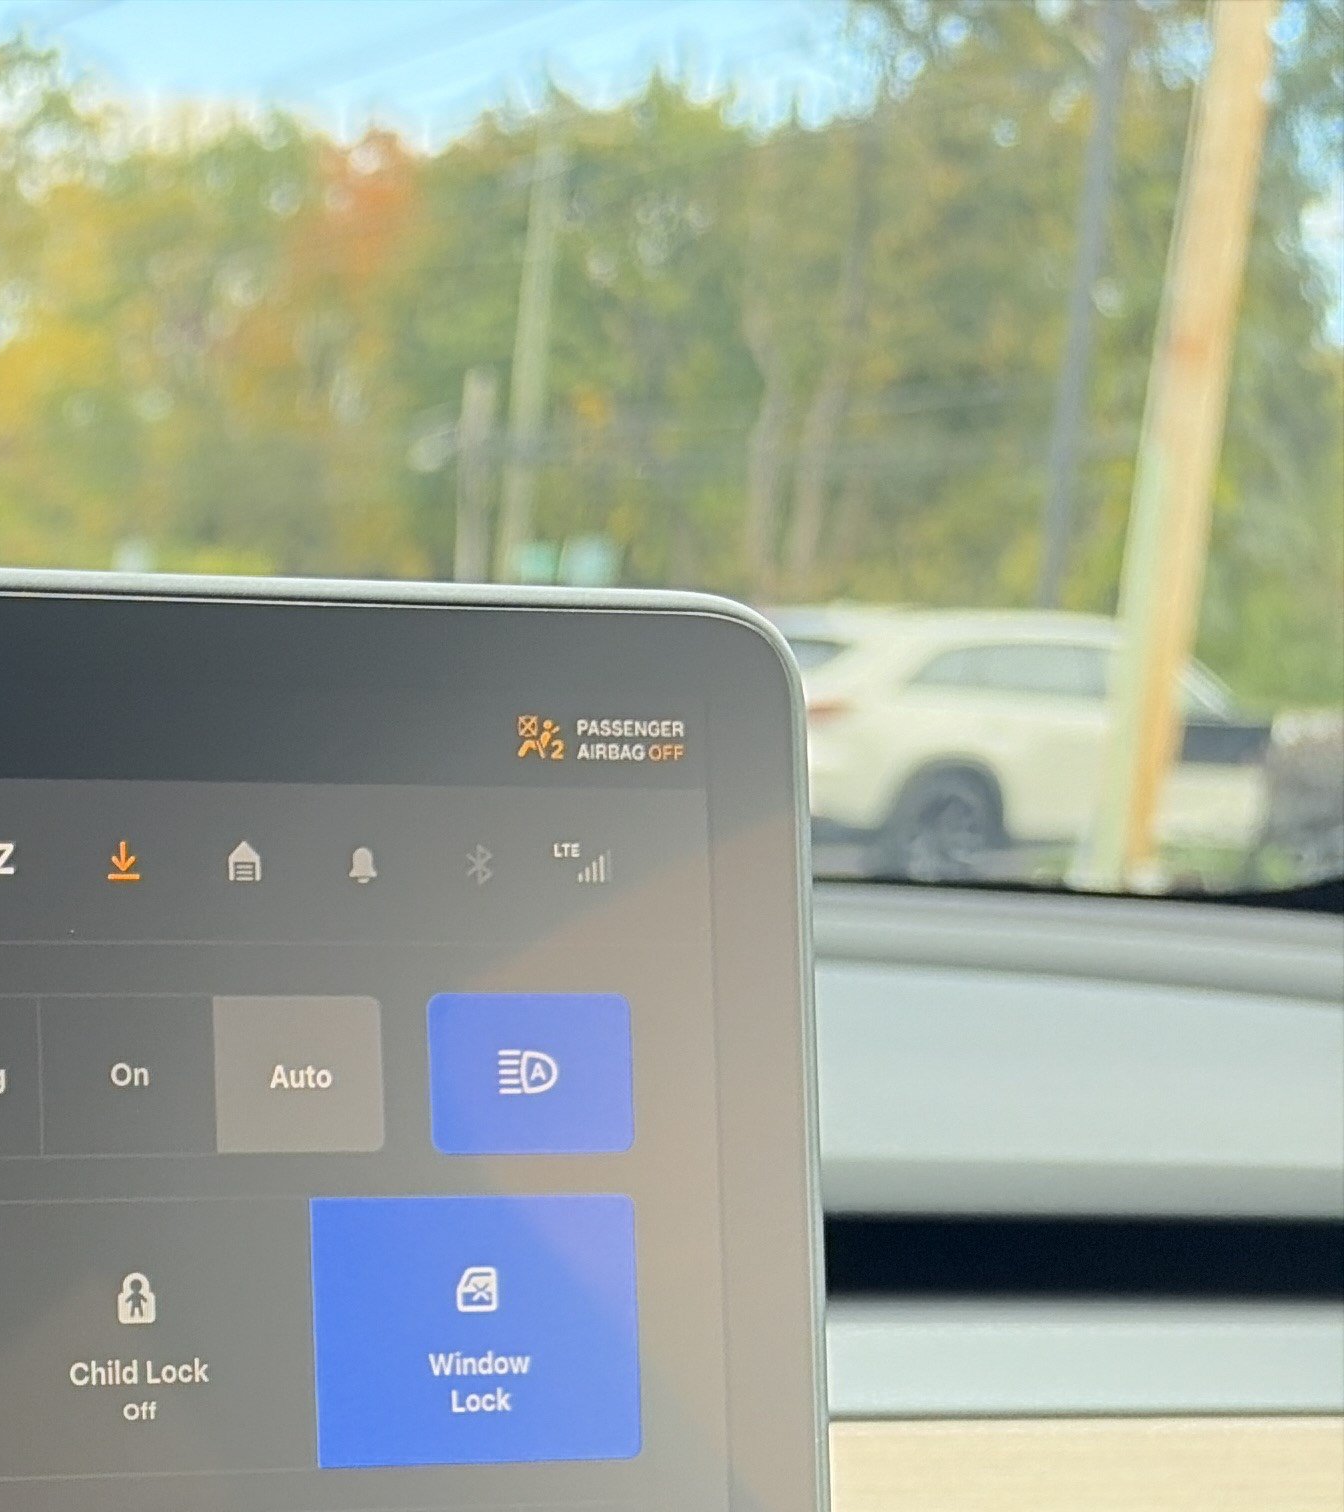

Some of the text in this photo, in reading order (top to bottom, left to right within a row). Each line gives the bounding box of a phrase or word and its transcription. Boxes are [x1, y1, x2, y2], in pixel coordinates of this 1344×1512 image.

[576, 719, 685, 738] PASSENGER
[576, 743, 684, 761] AIRBAG OFF
[553, 842, 580, 858] LTE
[110, 1062, 150, 1087] On
[269, 1064, 333, 1089] Auto
[69, 1357, 210, 1386] Child Lock
[428, 1350, 531, 1378] Window
[122, 1401, 157, 1421] Off
[450, 1387, 512, 1414] Lock
